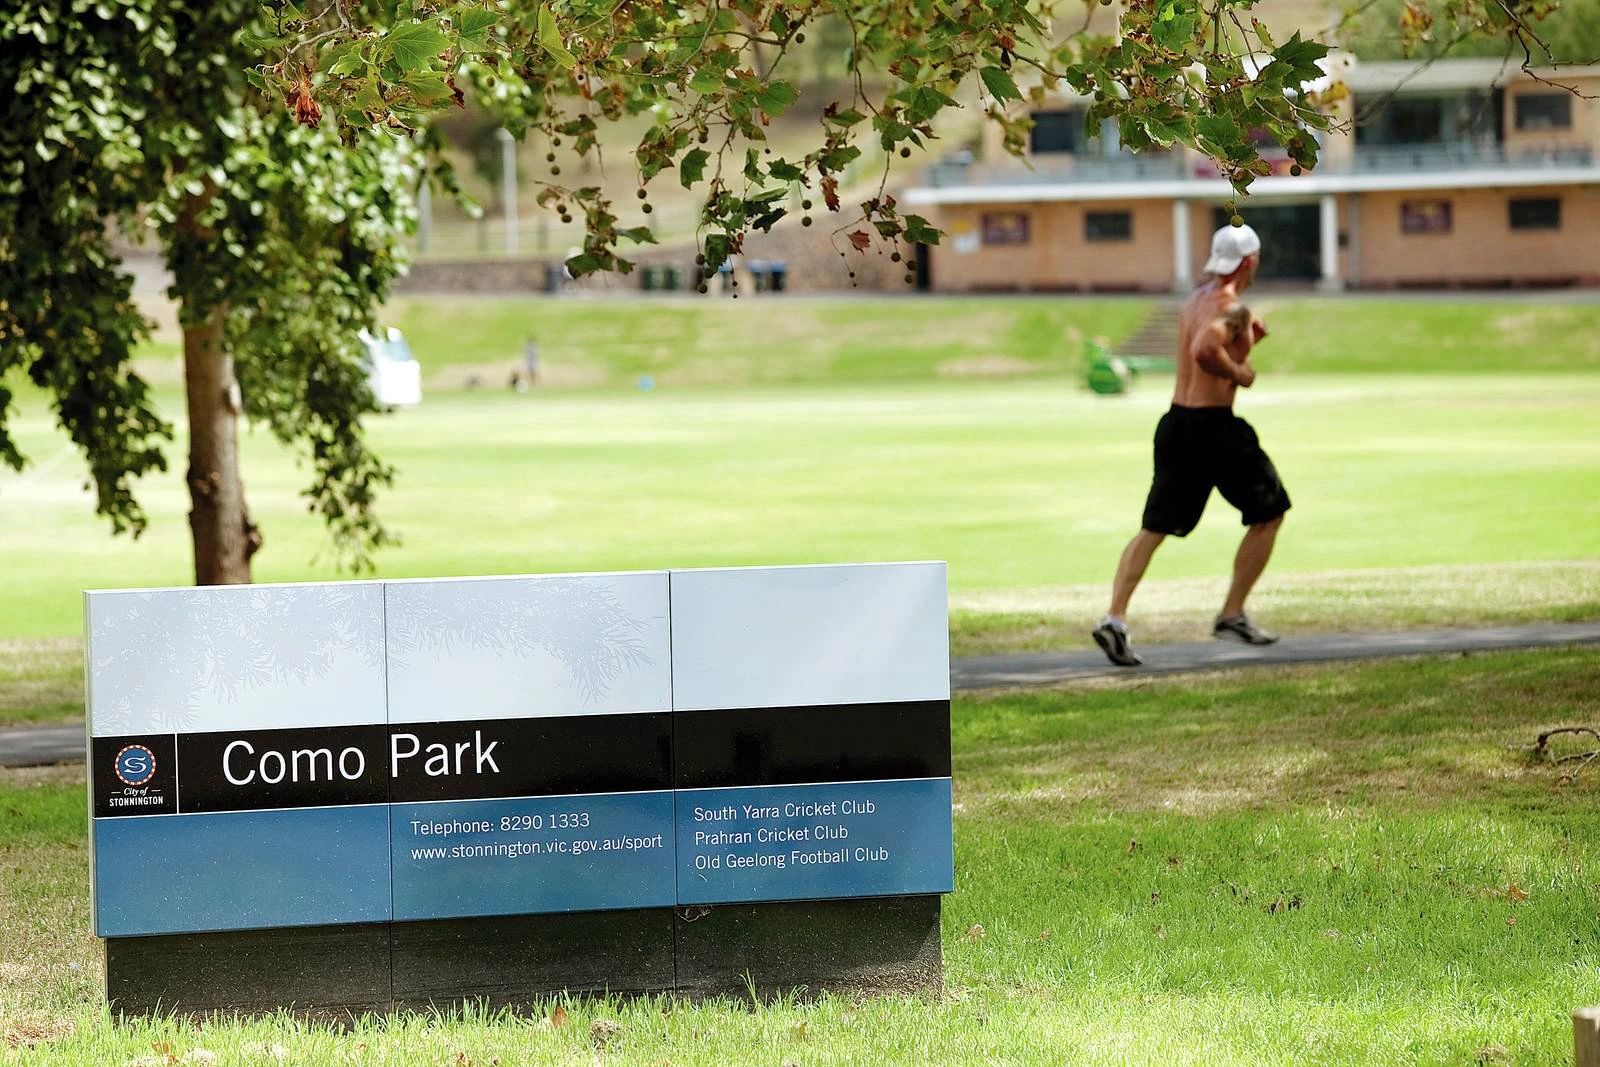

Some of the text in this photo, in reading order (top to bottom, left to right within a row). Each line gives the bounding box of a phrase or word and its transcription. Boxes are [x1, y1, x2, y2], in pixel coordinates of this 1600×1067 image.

[222, 730, 501, 785] Como Park
[109, 796, 163, 806] STONNINGTON
[123, 786, 149, 797] City of
[694, 799, 876, 821] South Yarra Cricket Club
[410, 812, 590, 838] Telephone: 8290 1333
[694, 825, 849, 846] Prahran Cricket Club
[411, 834, 663, 860] www.stonnington.vic.gov.au/sport
[694, 848, 889, 871] Old Geelong Football Club
